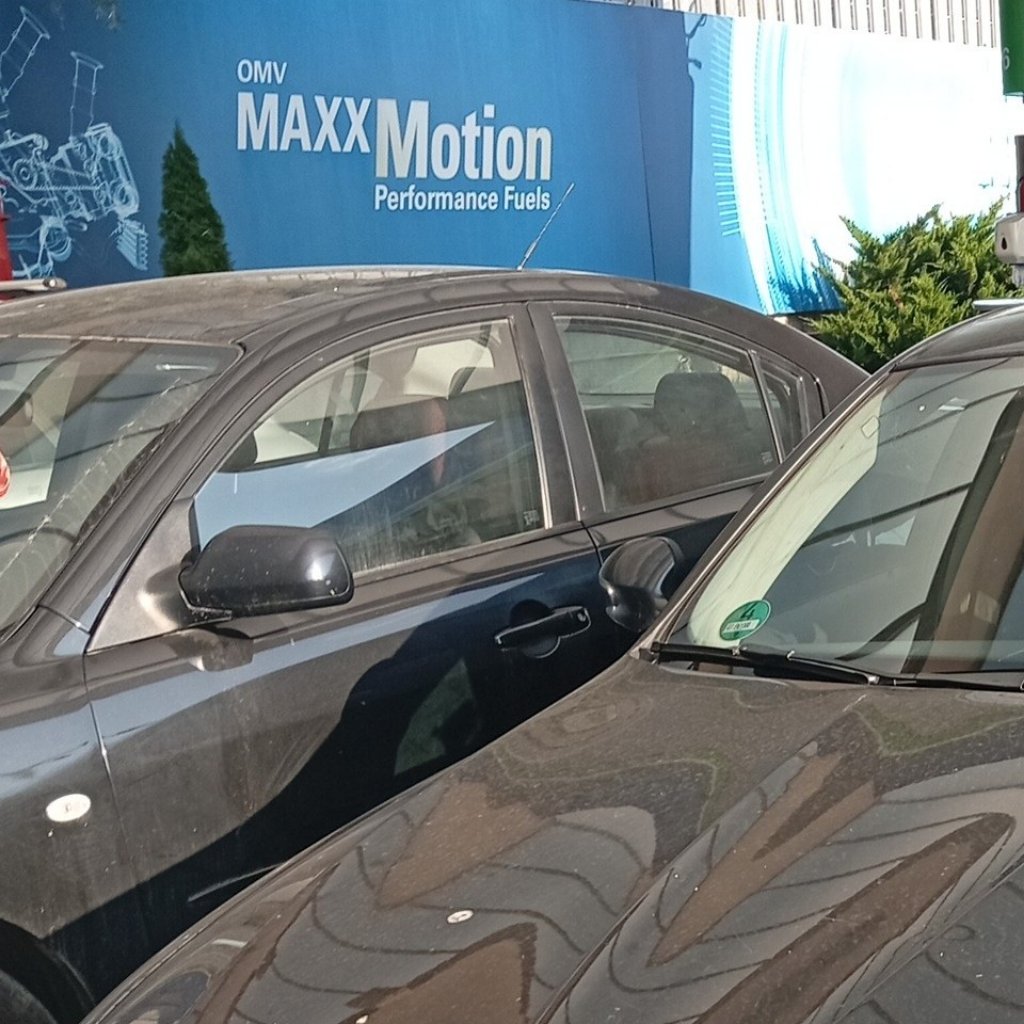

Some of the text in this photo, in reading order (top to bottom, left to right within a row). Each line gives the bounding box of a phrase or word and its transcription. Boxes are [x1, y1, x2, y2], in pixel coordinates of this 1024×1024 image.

[237, 59, 287, 84] OMV
[237, 92, 552, 181] MAXX Motion
[374, 184, 550, 211] Performance Fuels
